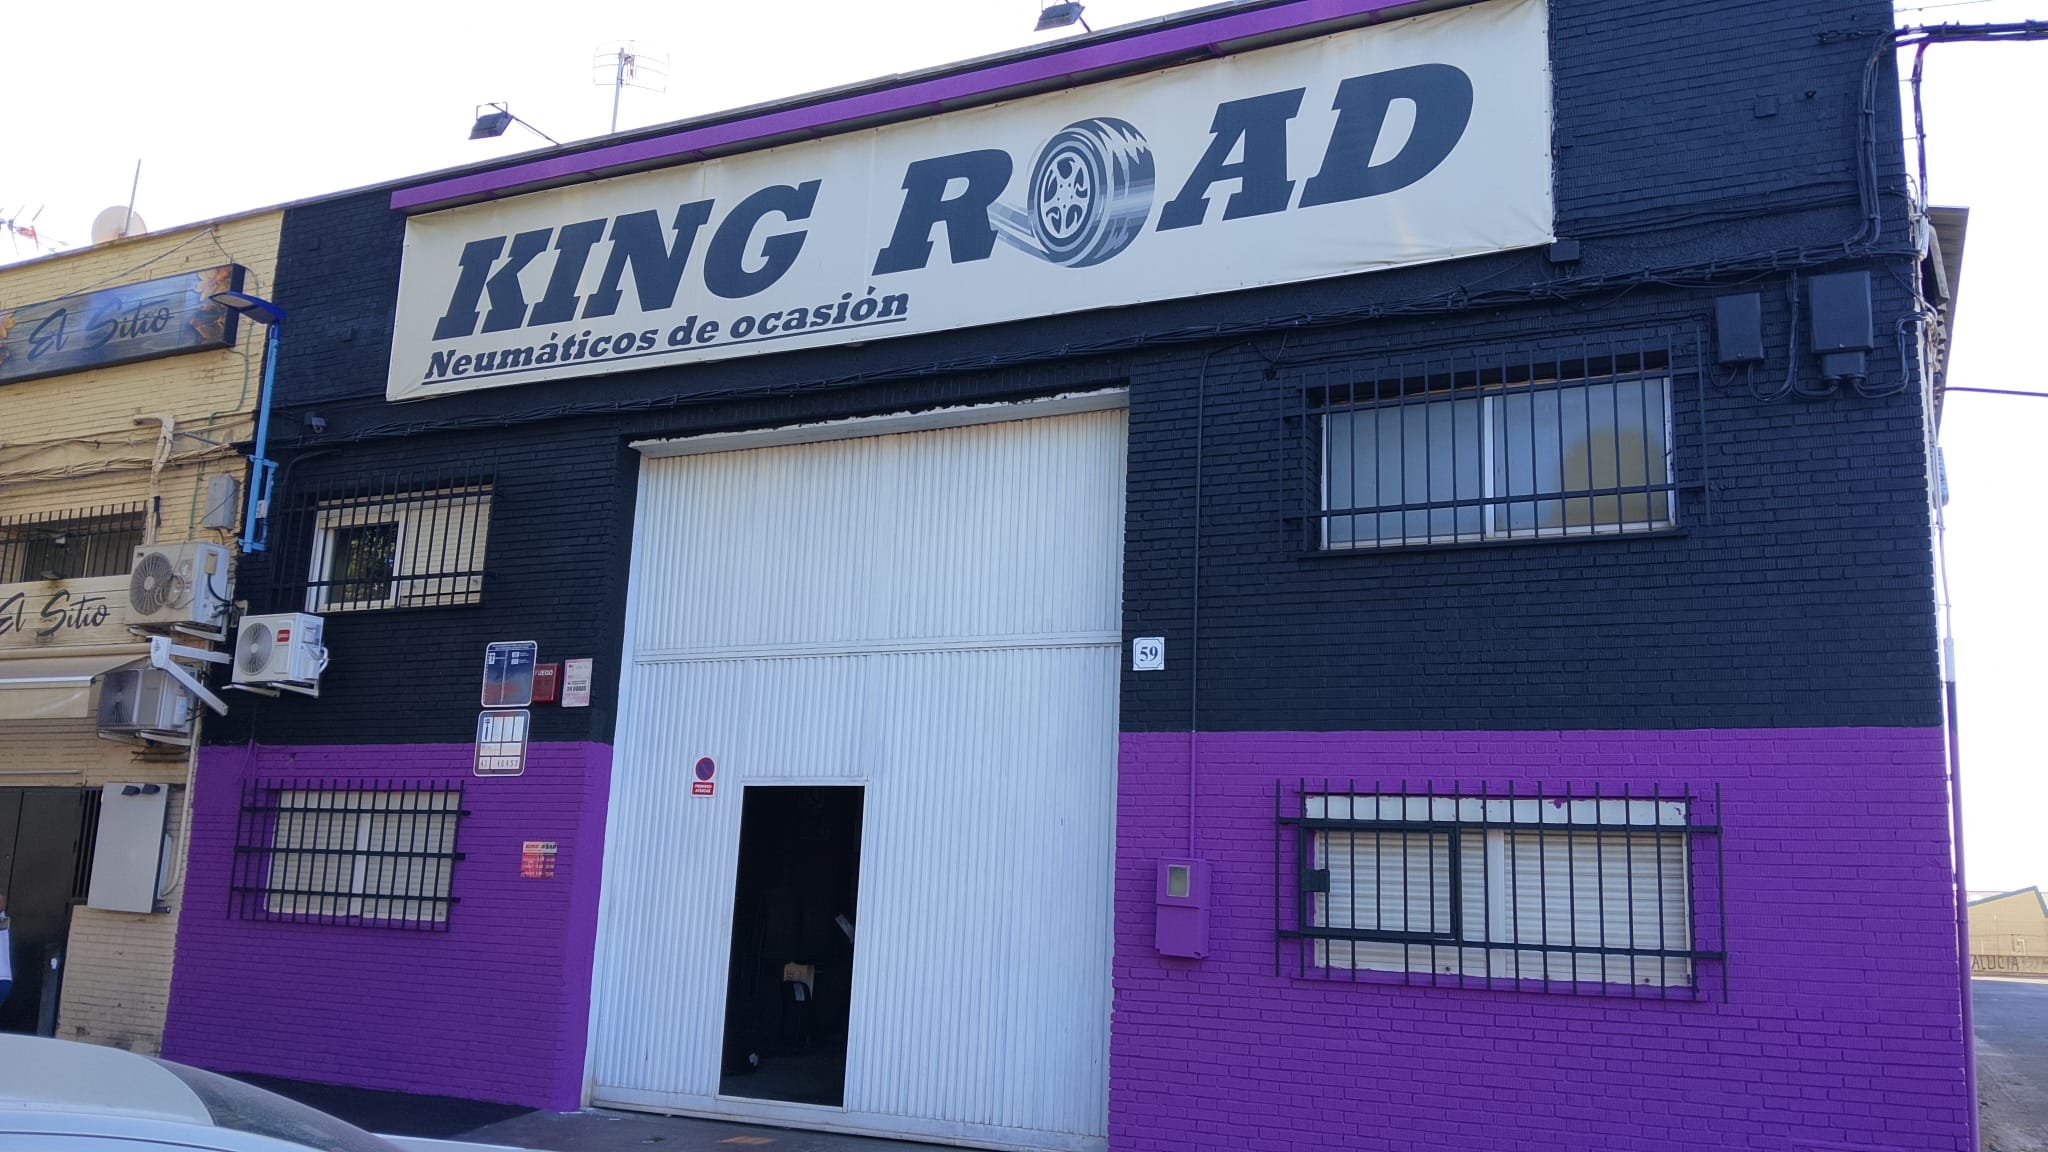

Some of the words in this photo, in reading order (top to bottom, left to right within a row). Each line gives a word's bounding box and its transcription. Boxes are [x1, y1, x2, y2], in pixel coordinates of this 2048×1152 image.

[432, 179, 822, 341] KING
[872, 63, 1474, 276] ROAD
[27, 308, 70, 361] El
[86, 297, 175, 352] Sitio
[424, 329, 659, 380] Neumáticos
[667, 315, 720, 346] de
[730, 286, 909, 339] ocasión
[0, 592, 25, 635] El
[37, 589, 110, 637] Sitio
[1140, 645, 1159, 662] 59
